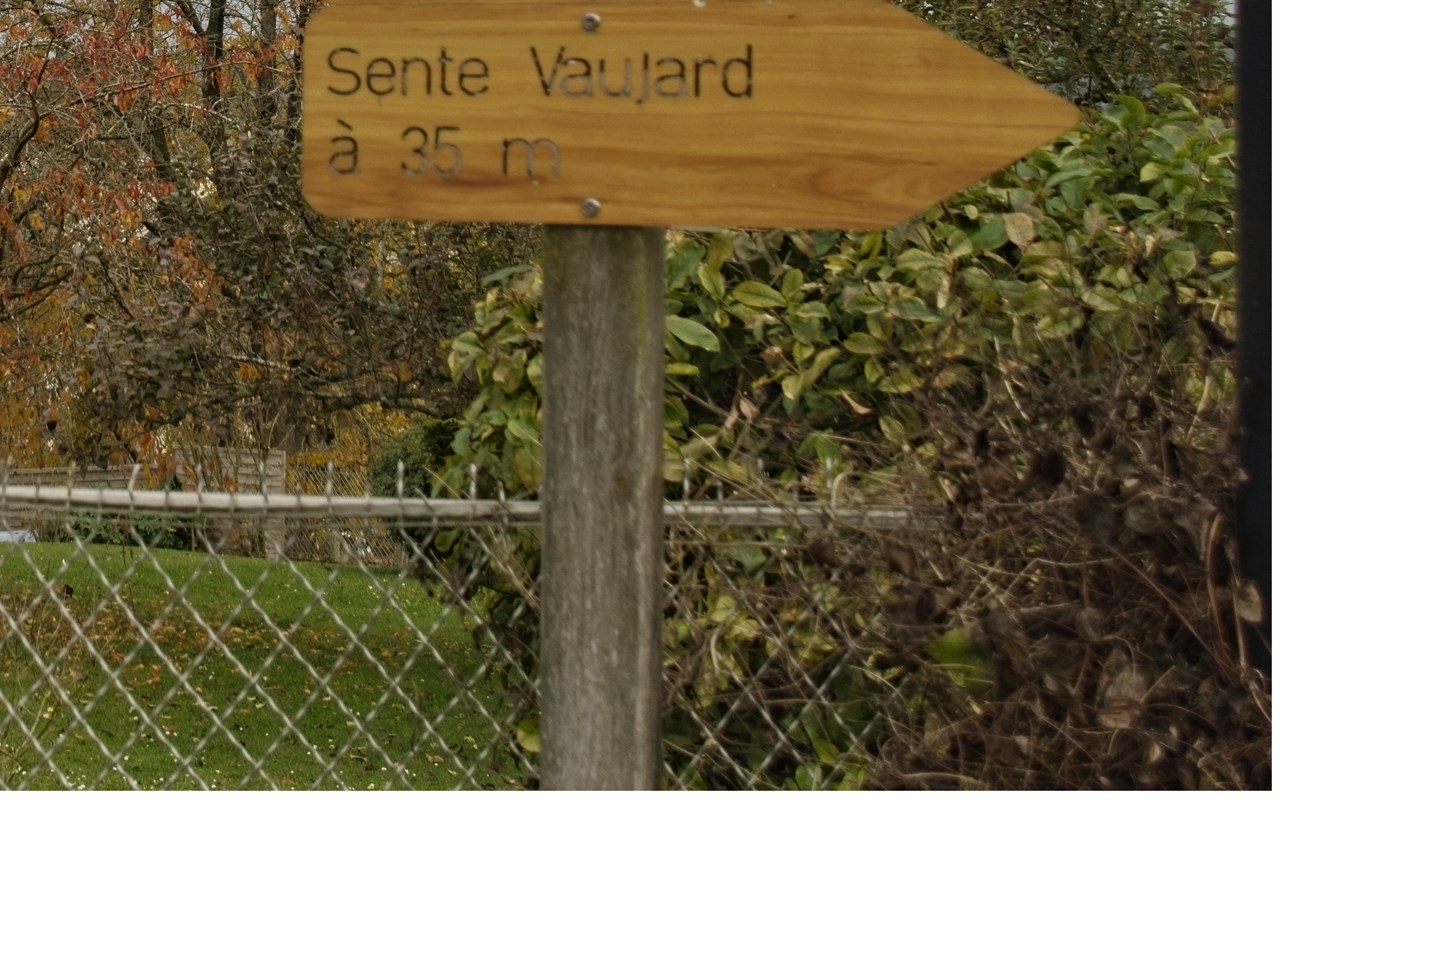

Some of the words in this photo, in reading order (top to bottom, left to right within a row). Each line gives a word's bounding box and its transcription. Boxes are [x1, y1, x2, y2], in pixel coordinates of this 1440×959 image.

[327, 46, 490, 98] Sente
[529, 44, 755, 105] Vaujard
[328, 118, 359, 176] à
[400, 126, 462, 178] 35
[500, 136, 561, 178] m
